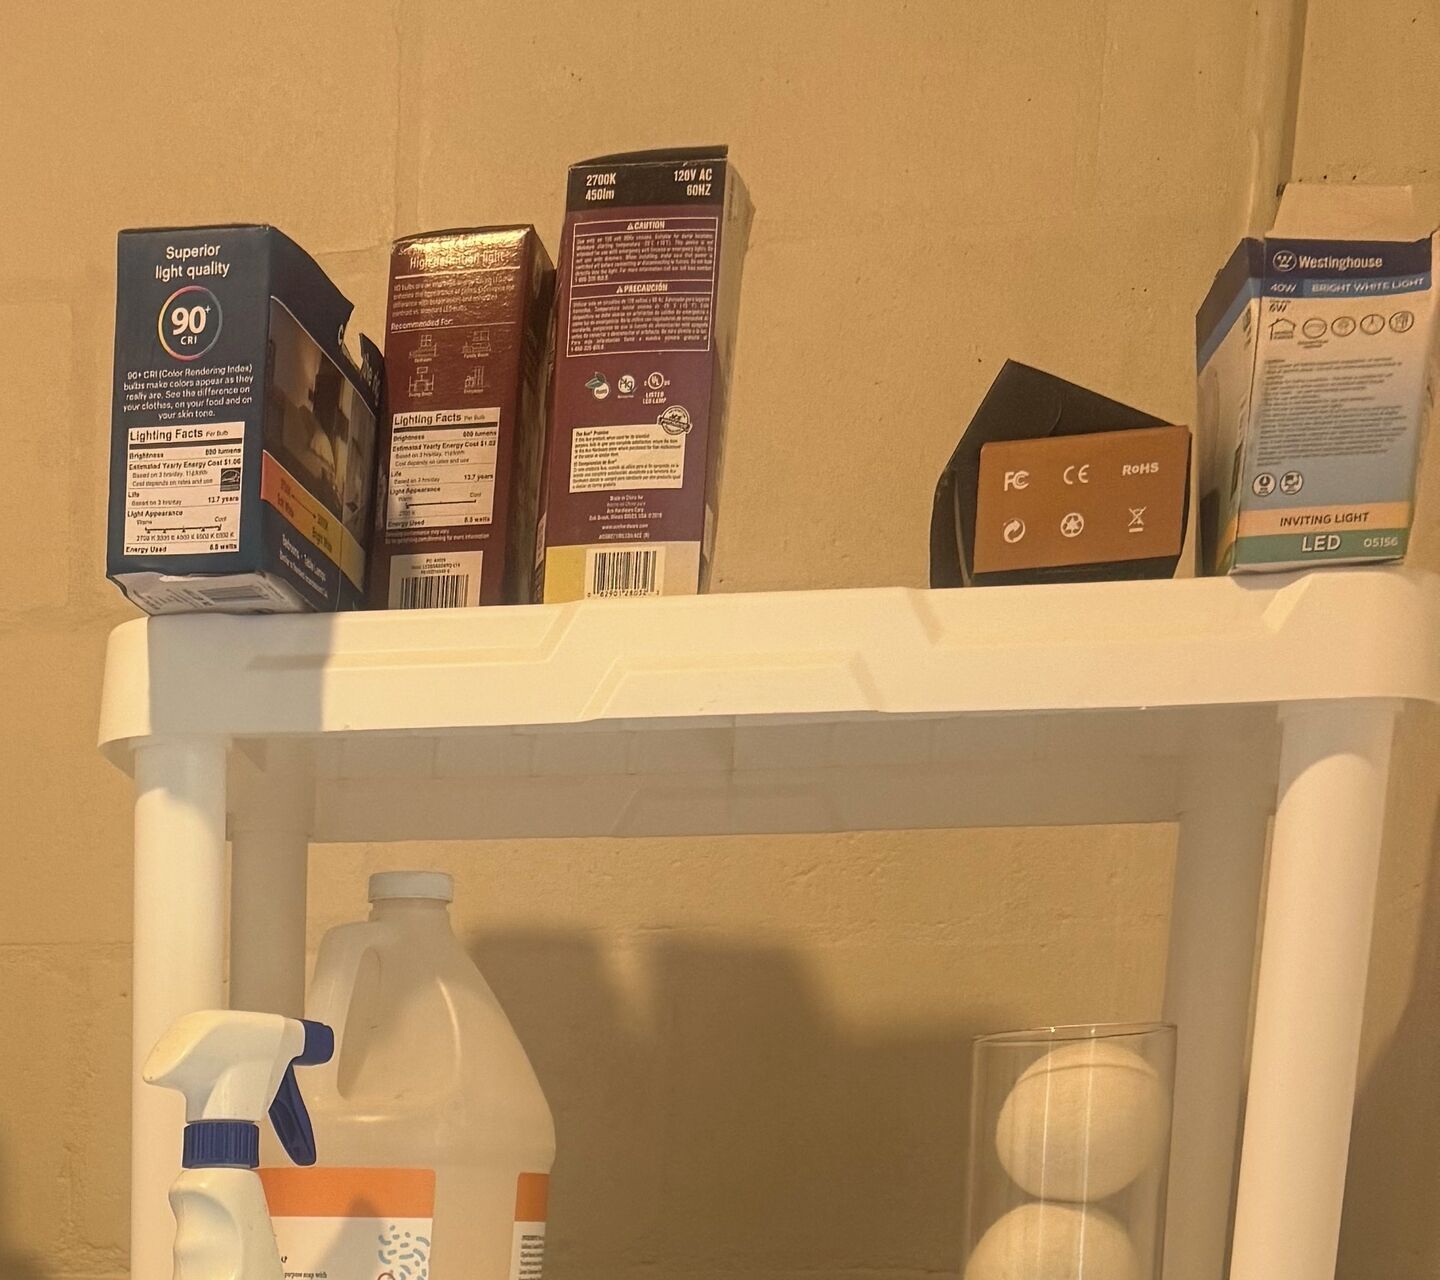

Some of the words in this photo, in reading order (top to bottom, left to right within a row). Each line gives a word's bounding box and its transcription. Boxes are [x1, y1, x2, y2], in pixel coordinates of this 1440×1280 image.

[586, 173, 616, 186] 2700K
[674, 169, 696, 182] 120V
[699, 169, 712, 181] AC
[586, 189, 614, 201] 450lm
[687, 184, 711, 196] 60HZ
[634, 221, 664, 230] CAUTION
[166, 244, 220, 262] Superior
[1299, 256, 1382, 271] Westinghouse
[156, 262, 182, 282] light
[187, 262, 230, 281] quality
[624, 282, 667, 293] PRECAUCIÓN
[1270, 282, 1296, 292] 40W
[1312, 283, 1350, 292] BRIGHT
[1354, 282, 1389, 291] WHITE
[1392, 278, 1424, 289] LIGHT
[1269, 304, 1287, 312] 6W
[181, 336, 197, 345] CRI
[394, 414, 432, 426] Lighting
[436, 412, 461, 423] Facts
[130, 430, 172, 442] Lighting
[175, 429, 203, 439] Facts
[1122, 463, 1159, 475] RoHS
[1280, 515, 1331, 527] INVITING
[1335, 512, 1369, 523] LIGHT
[1302, 535, 1340, 552] LED
[1363, 537, 1398, 548] 05156
